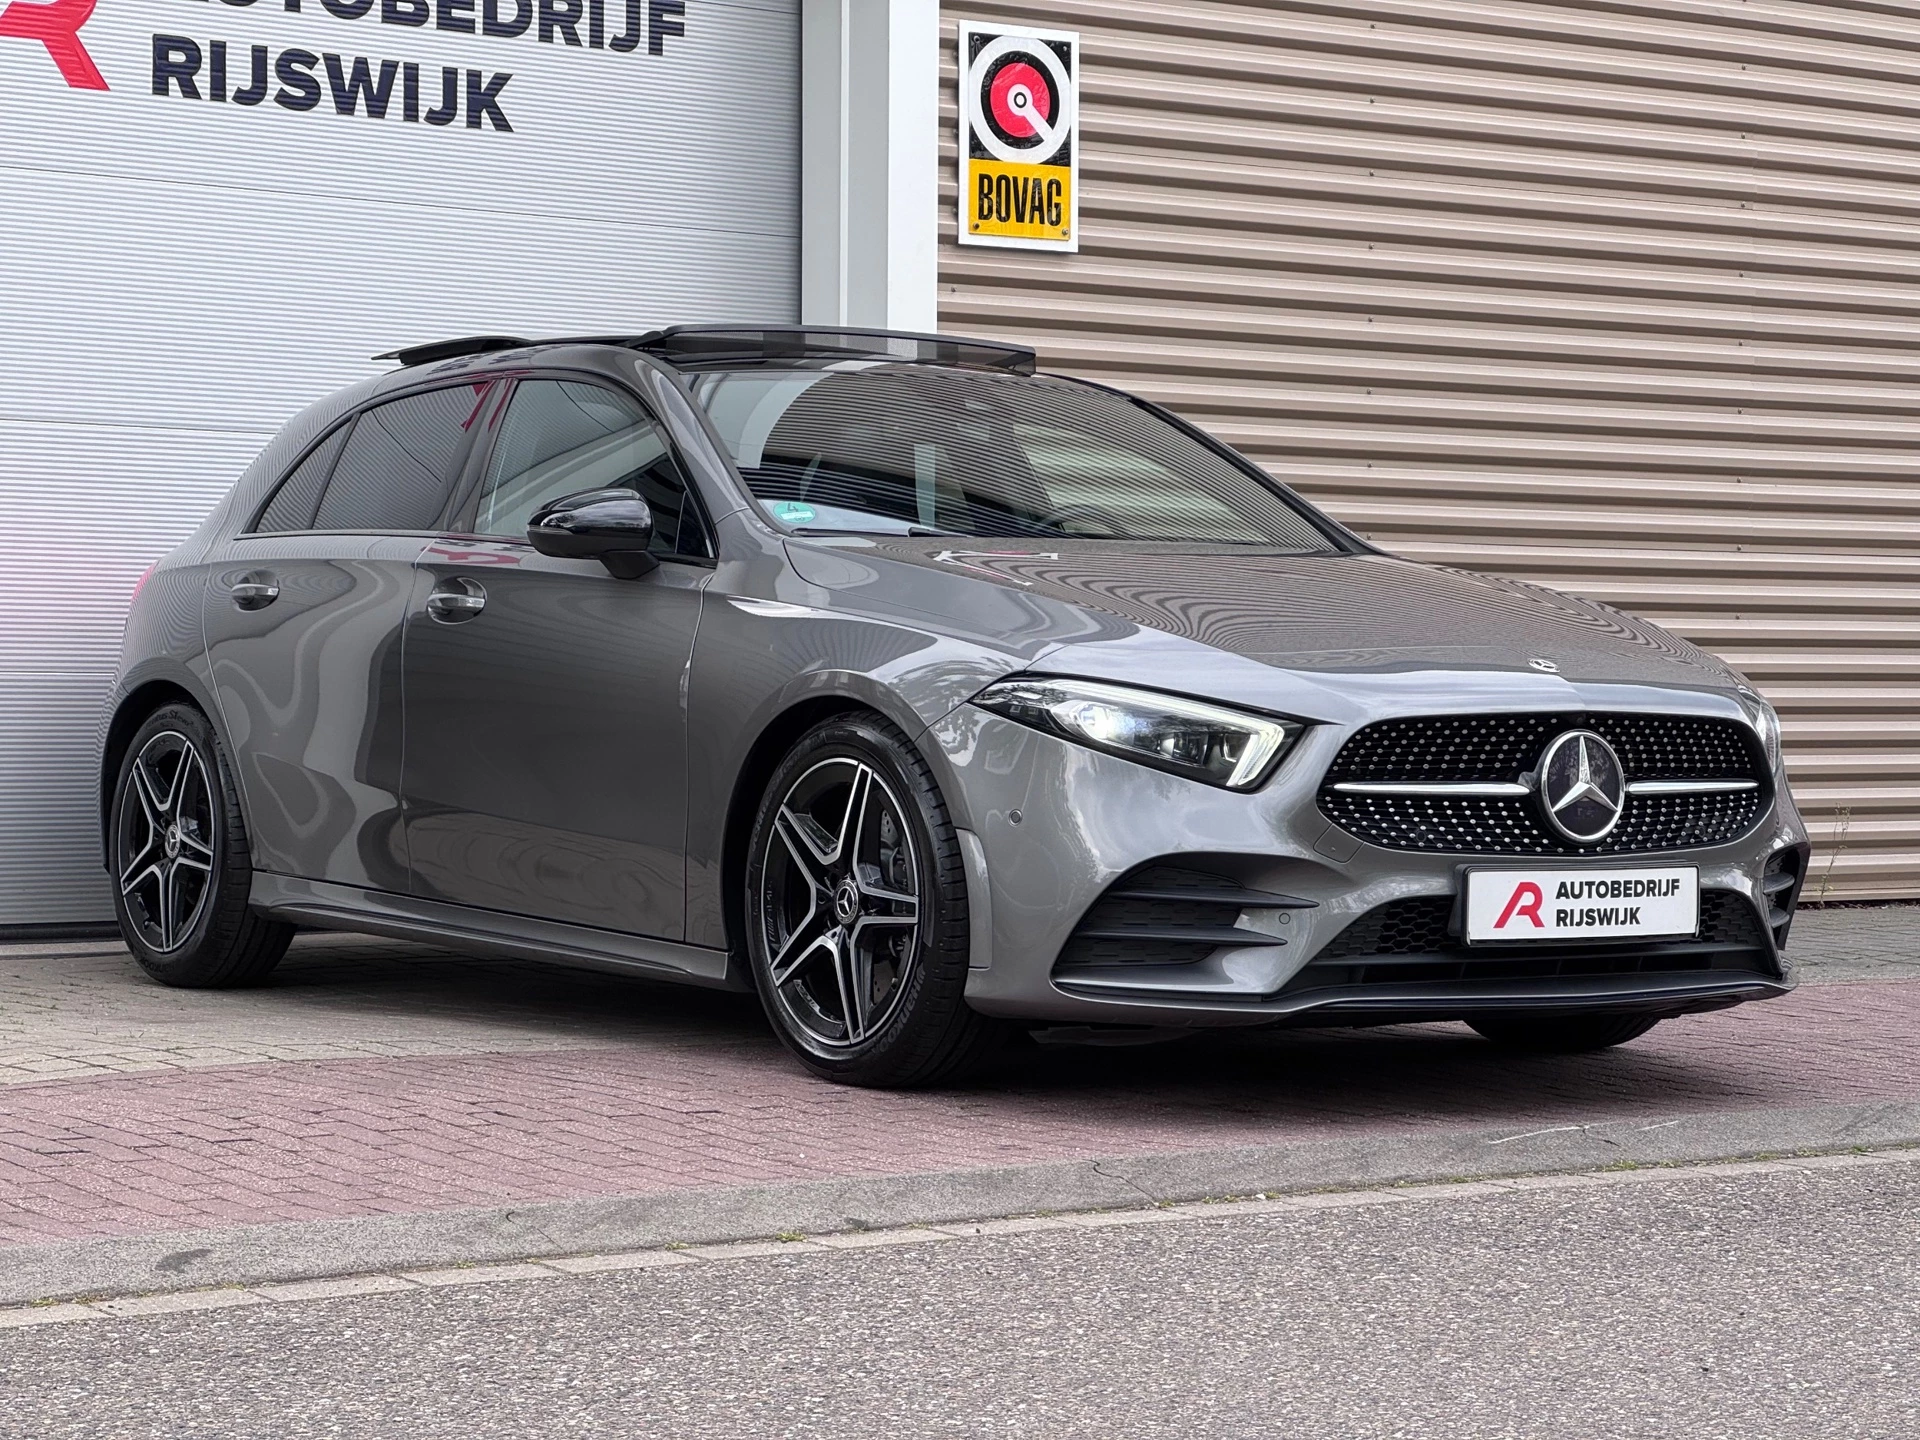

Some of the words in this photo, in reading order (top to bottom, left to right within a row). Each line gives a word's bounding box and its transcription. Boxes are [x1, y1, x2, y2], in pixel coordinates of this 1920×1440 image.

[152, 33, 514, 133] RIJSWIJK
[978, 173, 1062, 227] BOVAG
[1555, 878, 1680, 900] AUTOBEDRIJF
[1555, 907, 1641, 927] RIJSWIJK
